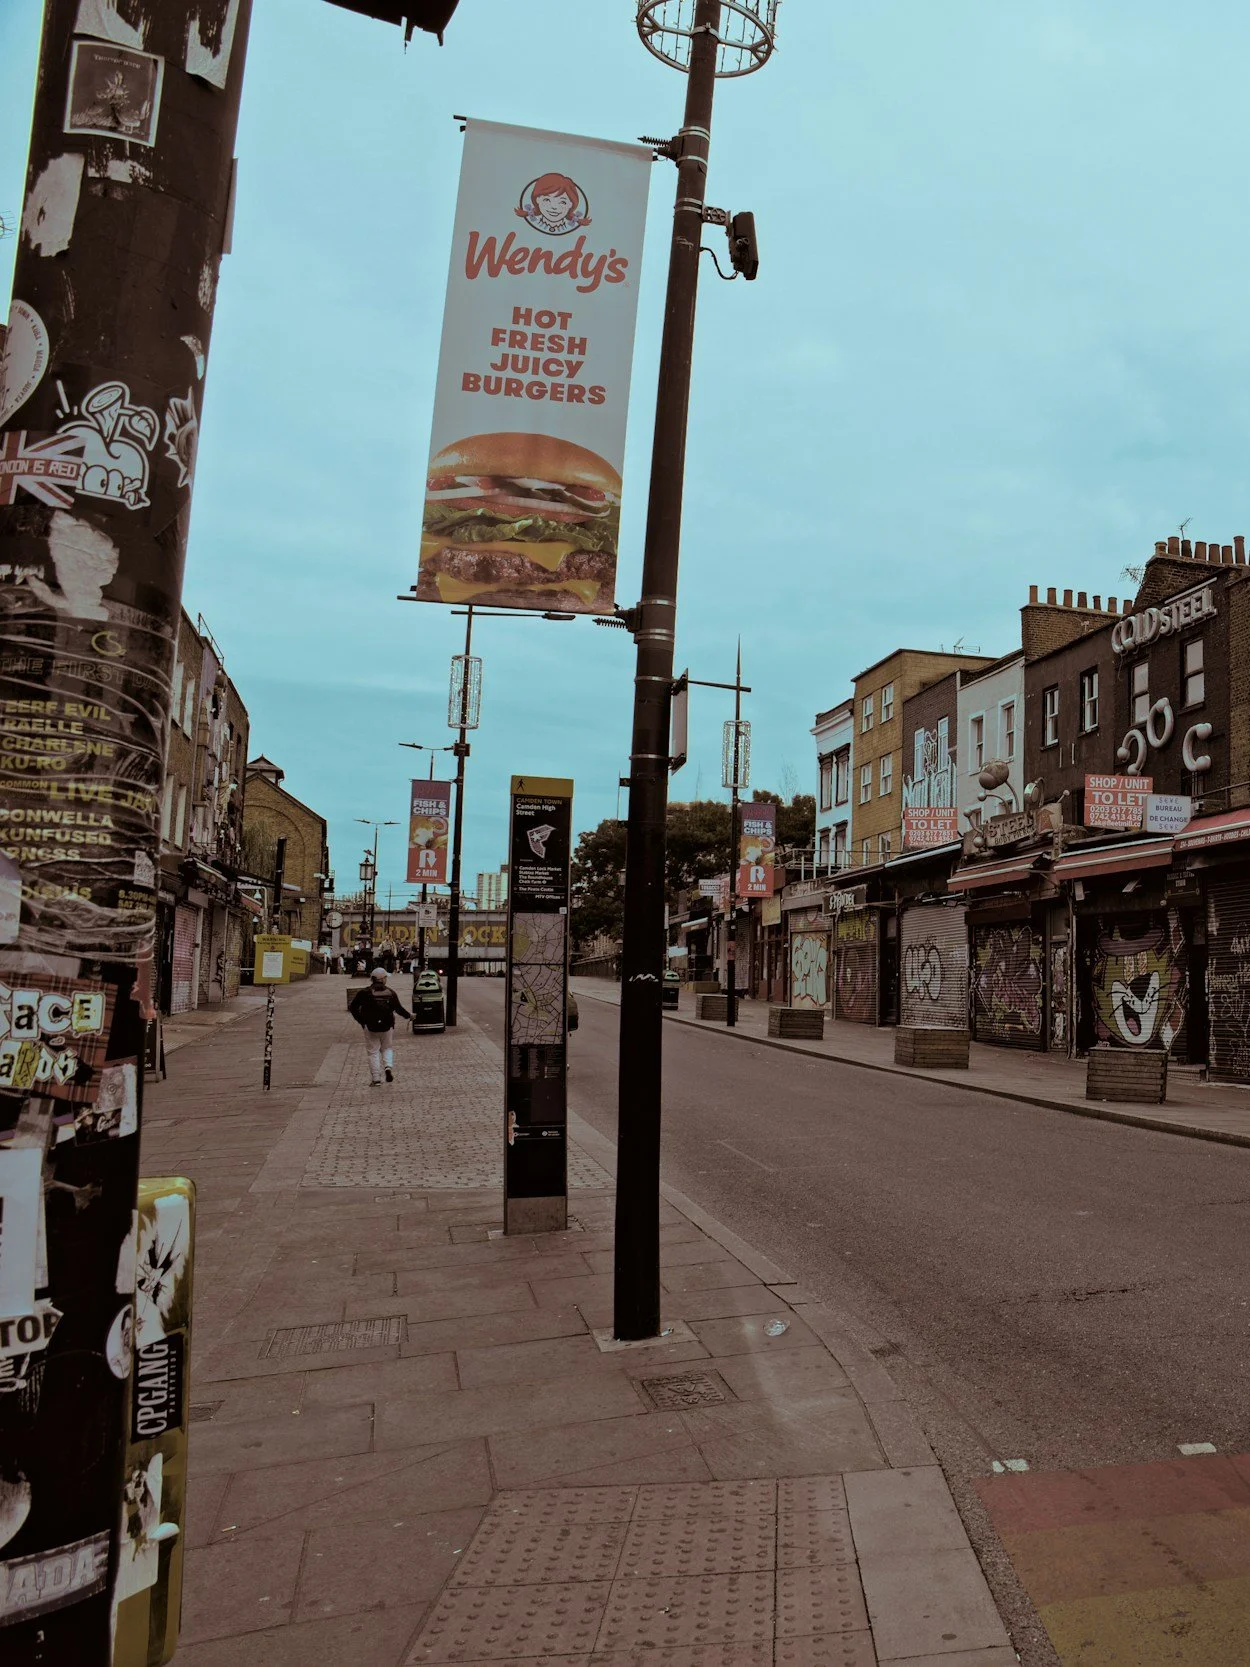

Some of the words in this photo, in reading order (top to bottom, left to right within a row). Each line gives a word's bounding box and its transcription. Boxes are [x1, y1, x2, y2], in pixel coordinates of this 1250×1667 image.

[465, 231, 629, 293] Wendy's
[512, 306, 572, 332] HOT
[490, 327, 588, 356] FRESH
[490, 352, 584, 380] JUICY
[462, 372, 606, 405] BURGERS
[33, 461, 45, 474] IS
[49, 462, 77, 478] RED
[1160, 586, 1218, 636] STEEL
[52, 659, 126, 685] FIRST
[64, 702, 111, 721] EVIL
[2, 736, 117, 757] CHARLENE
[51, 782, 113, 804] LIVE
[1090, 777, 1117, 788] SHOP
[1125, 778, 1149, 789] UNIT
[413, 800, 437, 808] FISH
[438, 801, 447, 809] &
[1092, 791, 1114, 804] TO
[1118, 792, 1147, 806] LET
[413, 807, 447, 816] CHIPS
[908, 809, 930, 817] SHOP
[935, 809, 955, 817] UNIT
[911, 820, 928, 829] TO
[930, 820, 953, 830] LET
[416, 869, 421, 877] 2
[422, 869, 438, 877] MIN
[747, 883, 753, 891] 2
[753, 883, 767, 891] MIN
[137, 1343, 169, 1435] CPGANG
